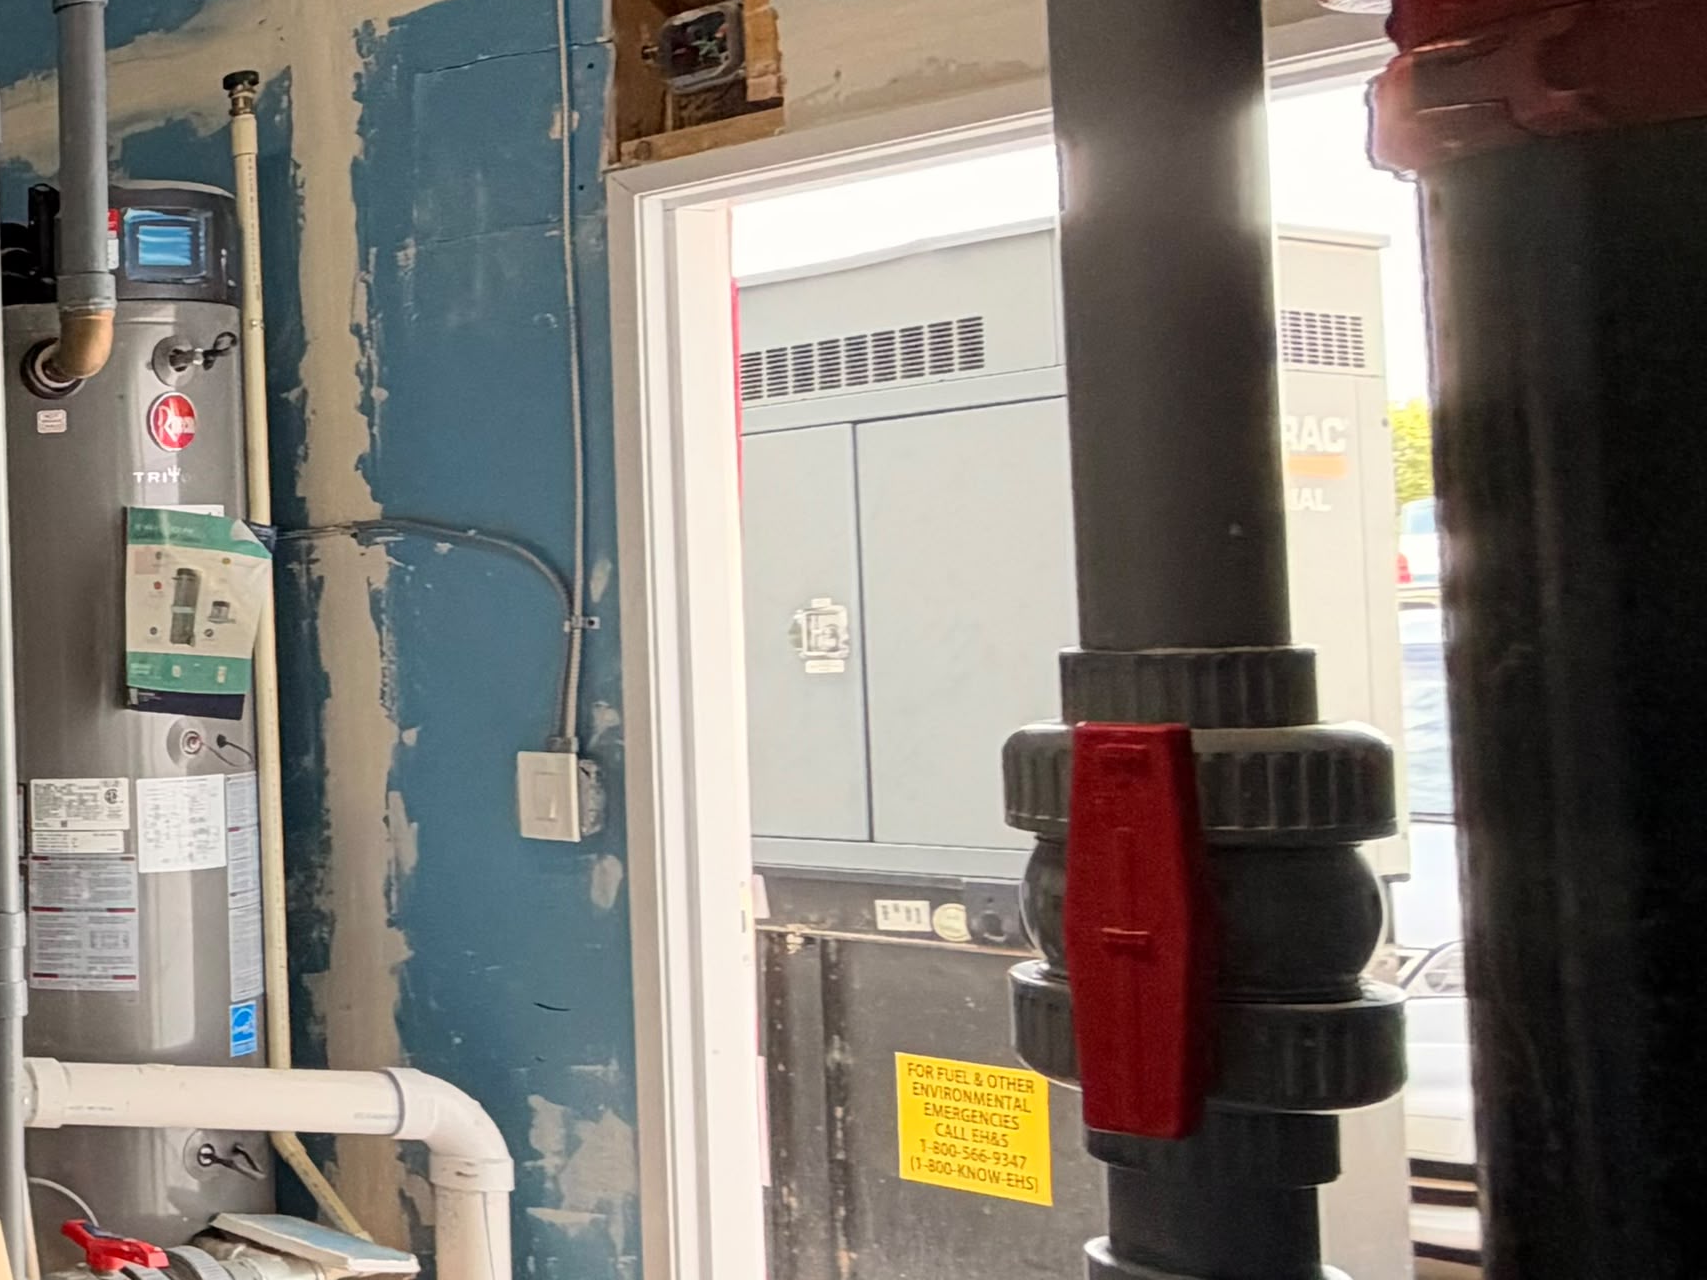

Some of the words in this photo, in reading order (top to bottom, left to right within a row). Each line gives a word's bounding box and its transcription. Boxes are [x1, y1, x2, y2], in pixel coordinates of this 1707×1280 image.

[907, 1062, 934, 1080] FOR
[937, 1067, 970, 1086] FUEL
[973, 1072, 984, 1087] &
[987, 1074, 1035, 1094] OTHER
[912, 1082, 1032, 1114] ENVIRONMENTAL
[924, 1102, 1019, 1130] EMERGENCIES
[934, 1123, 969, 1141] CALL
[972, 1129, 1009, 1148] EH&S
[919, 1138, 1027, 1170] 1-800-566-9347
[910, 1156, 1039, 1194] (1-800-KNOW-EHS)
